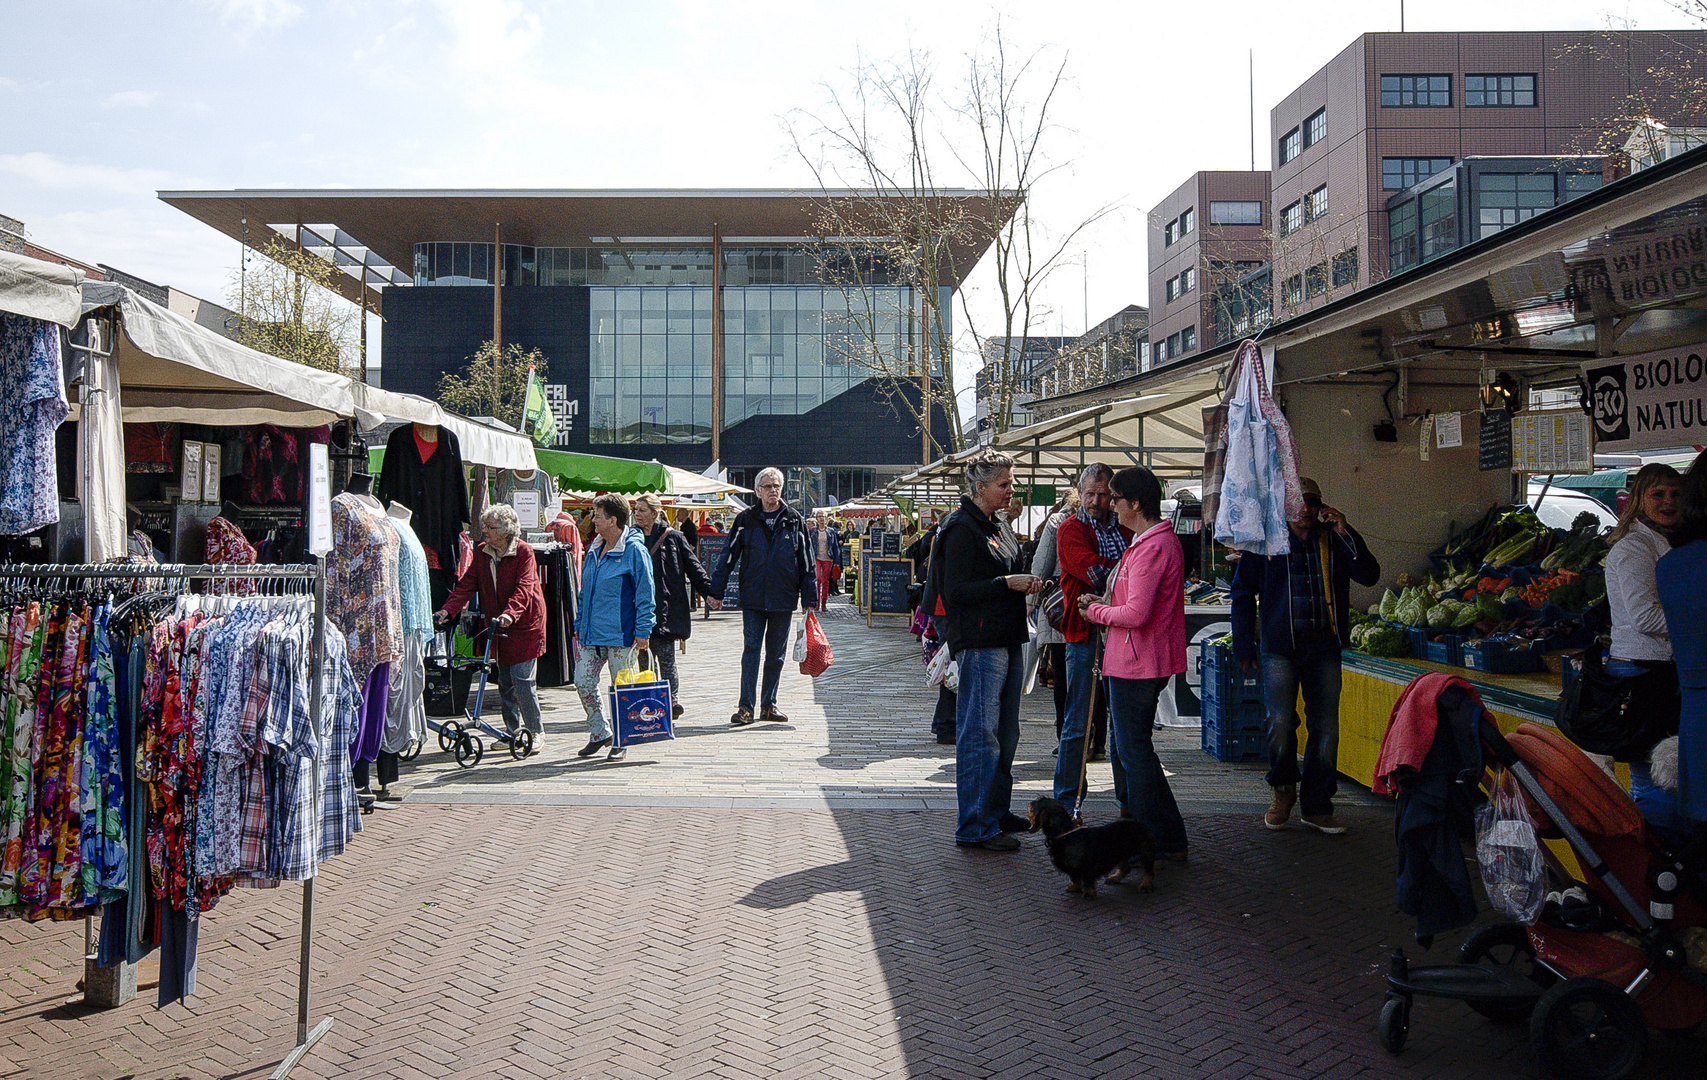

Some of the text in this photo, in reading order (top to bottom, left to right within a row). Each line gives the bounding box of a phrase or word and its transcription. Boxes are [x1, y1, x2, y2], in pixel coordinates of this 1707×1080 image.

[1633, 353, 1707, 390] BIOLO
[544, 384, 567, 399] FRI
[553, 415, 572, 430] SE
